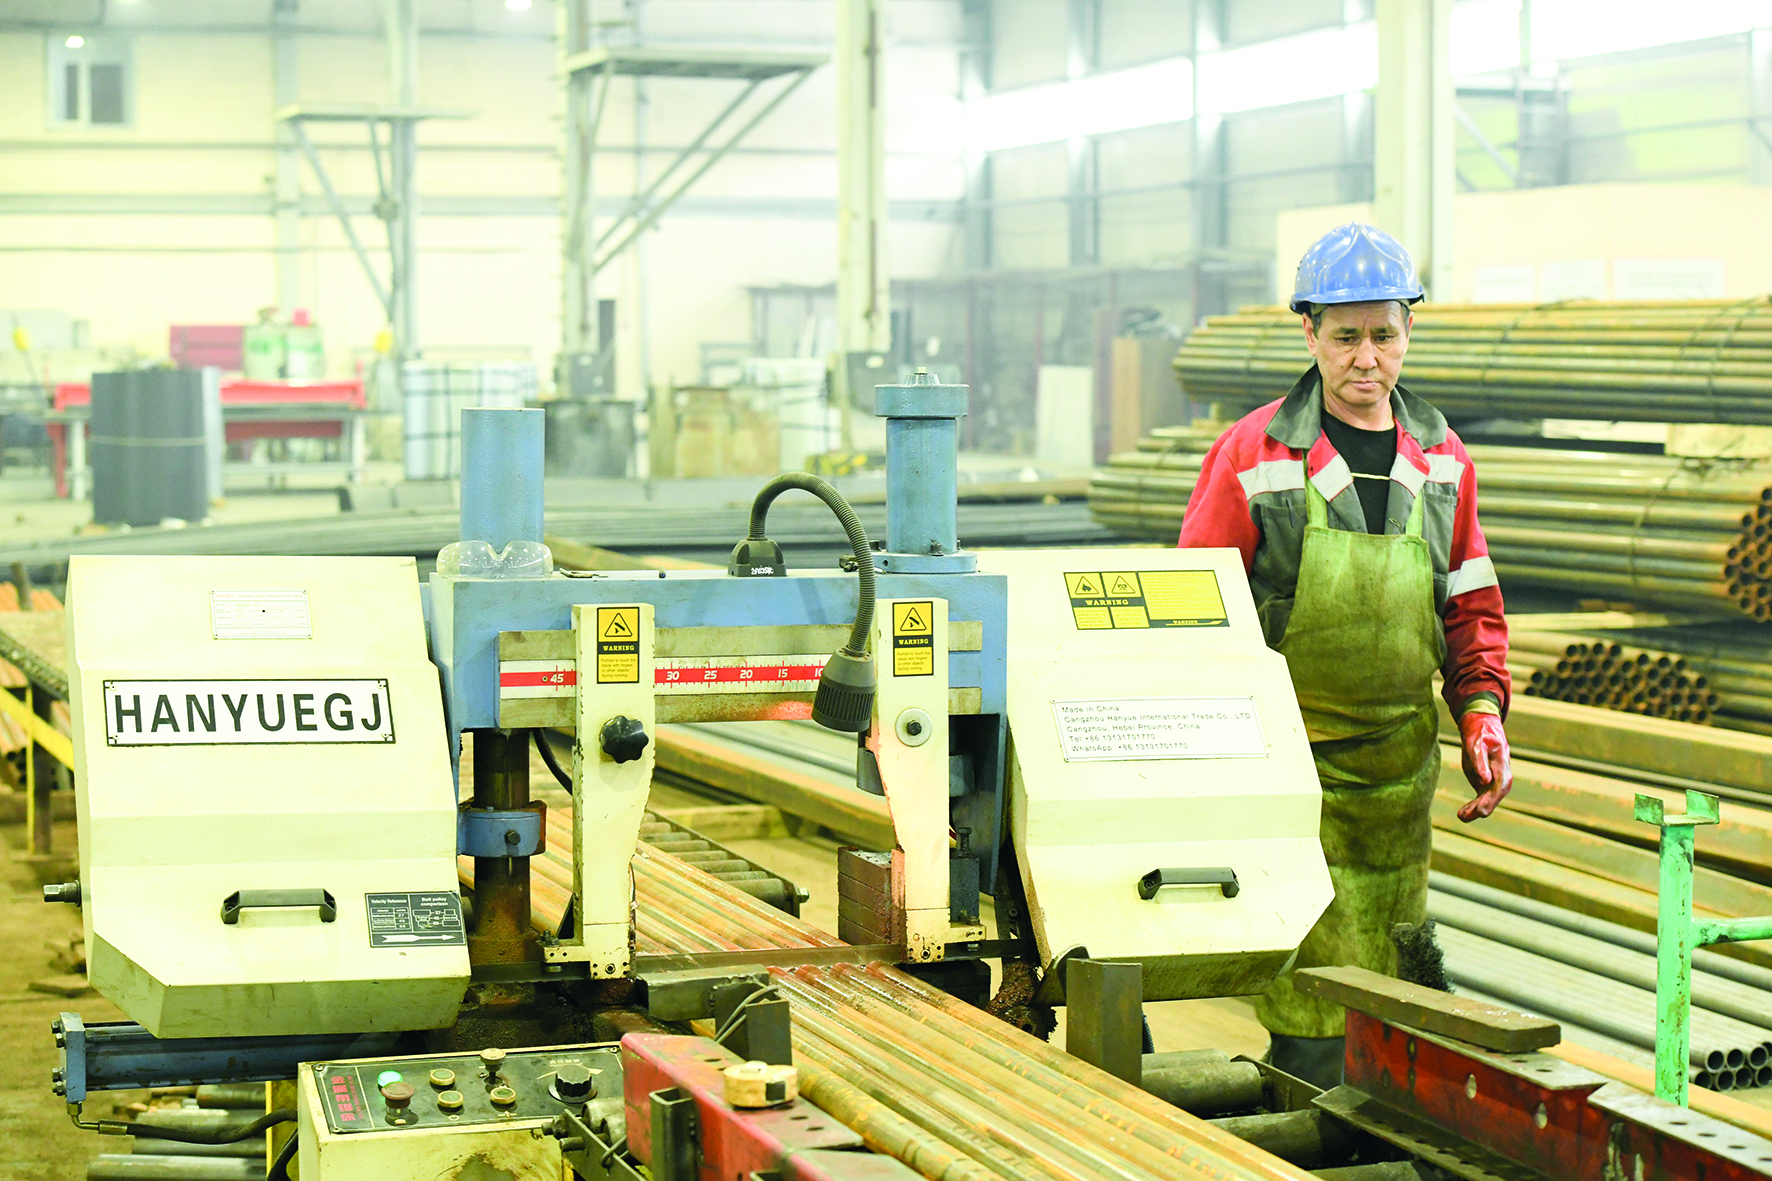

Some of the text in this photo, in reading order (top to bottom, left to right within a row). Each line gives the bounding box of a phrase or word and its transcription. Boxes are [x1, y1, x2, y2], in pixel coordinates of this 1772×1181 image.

[550, 673, 564, 683] 45
[666, 671, 680, 681] 30
[704, 670, 718, 680] 25
[740, 669, 753, 679] 20
[778, 668, 788, 678] 15
[114, 692, 382, 733] HANYUEGJ
[1103, 733, 1156, 741] 13131701770
[1136, 742, 1188, 750] 13131701770
